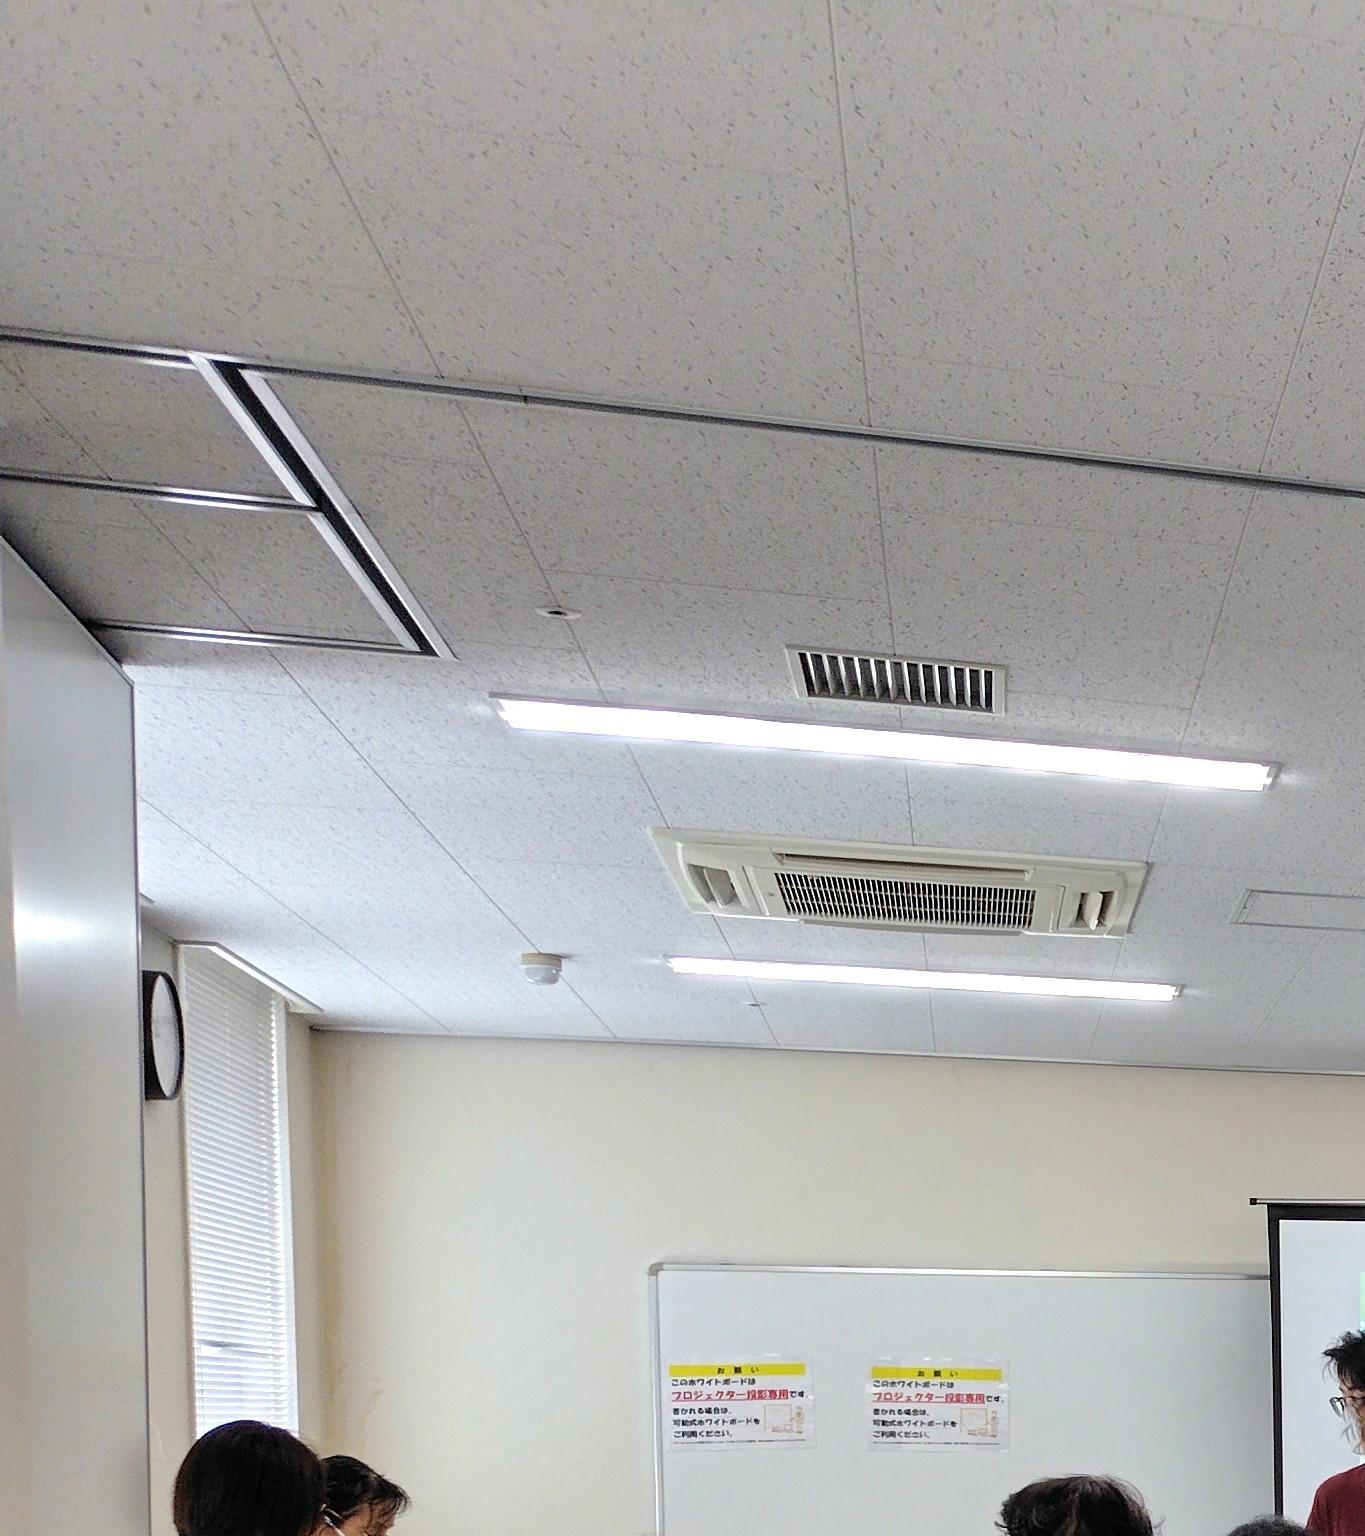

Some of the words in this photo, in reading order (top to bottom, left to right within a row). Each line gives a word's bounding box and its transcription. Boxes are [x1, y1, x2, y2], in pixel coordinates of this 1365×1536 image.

[671, 1377, 757, 1387] このホワイトボードは
[872, 1380, 955, 1389] このホワイトボードは
